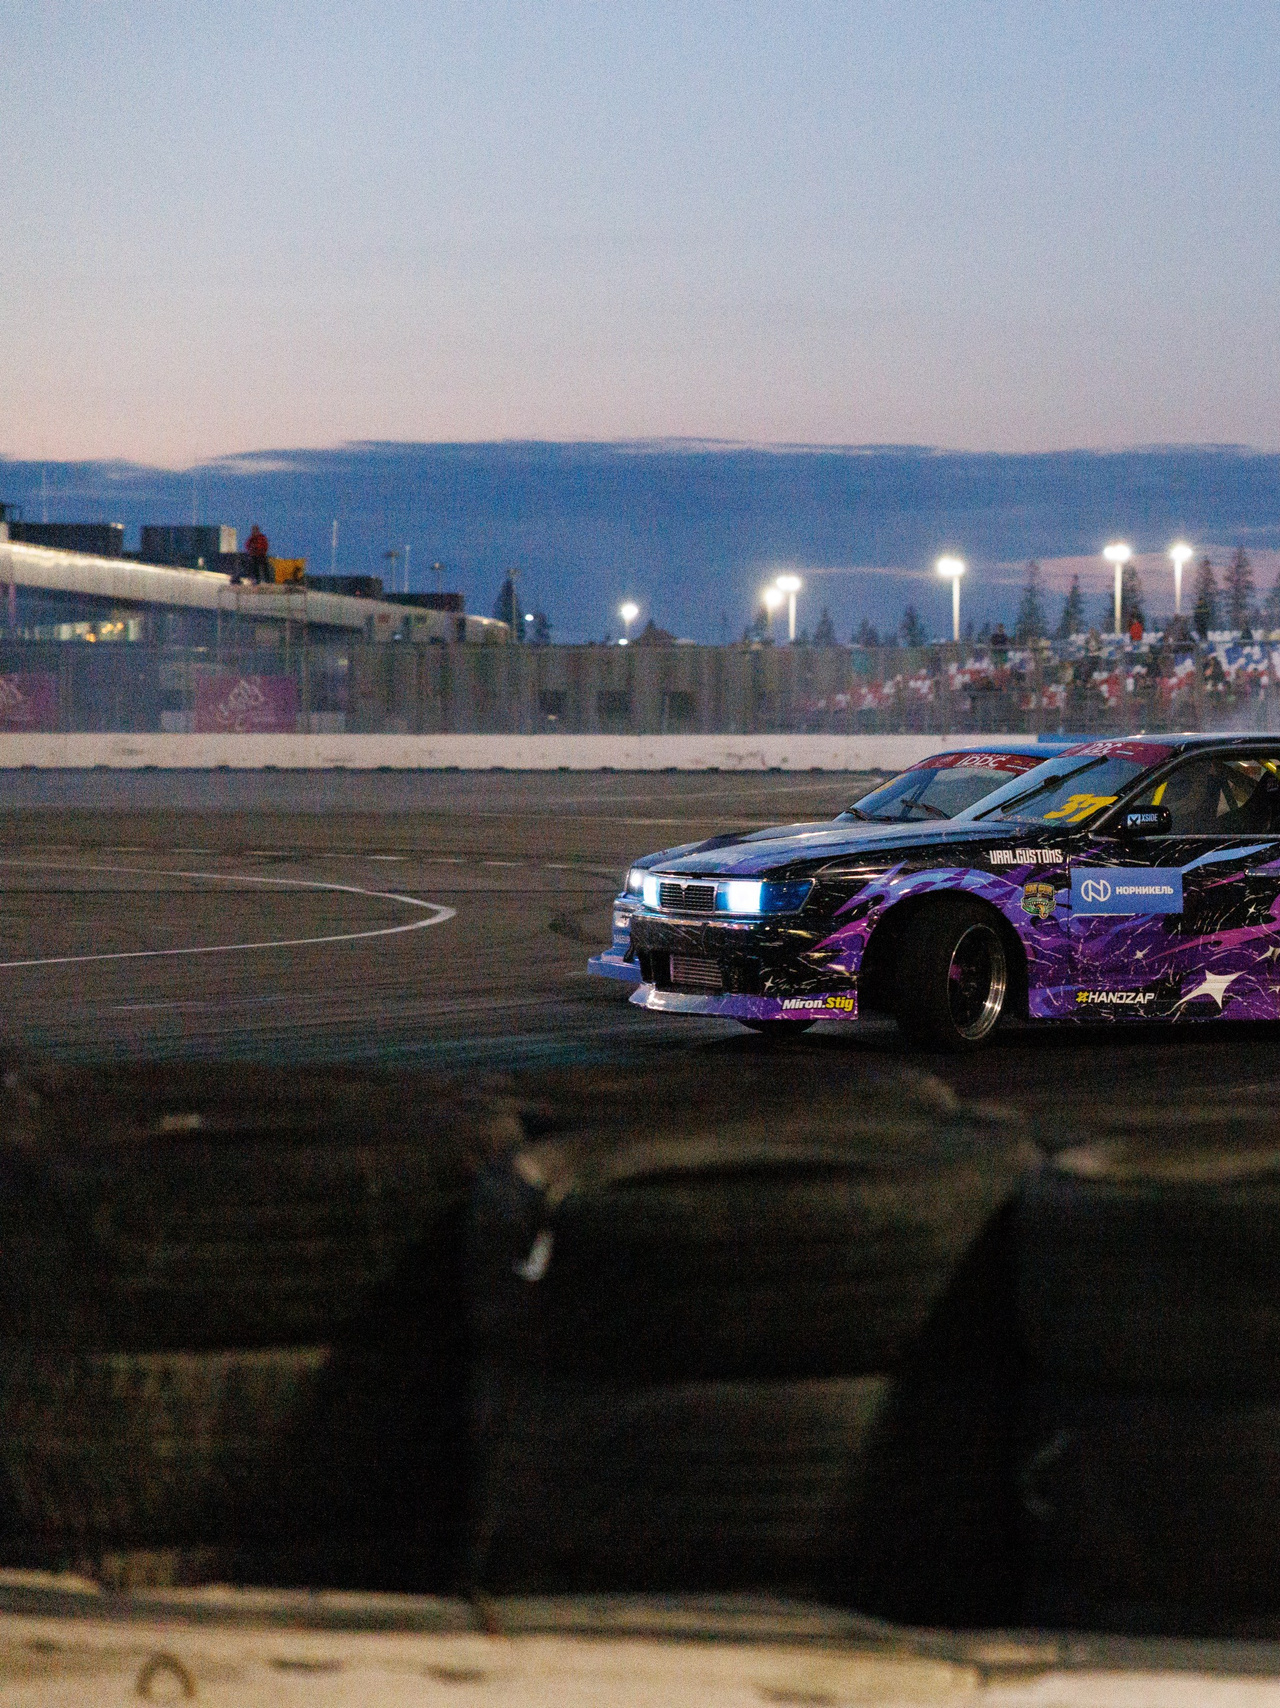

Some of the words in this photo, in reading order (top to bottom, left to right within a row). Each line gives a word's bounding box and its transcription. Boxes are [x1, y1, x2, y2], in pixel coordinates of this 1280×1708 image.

[952, 755, 1007, 768] IDDC
[1042, 793, 1119, 823] 37
[1115, 885, 1174, 895] НОРНИКЕЛЬ
[782, 996, 854, 1011] Miron.Stig
